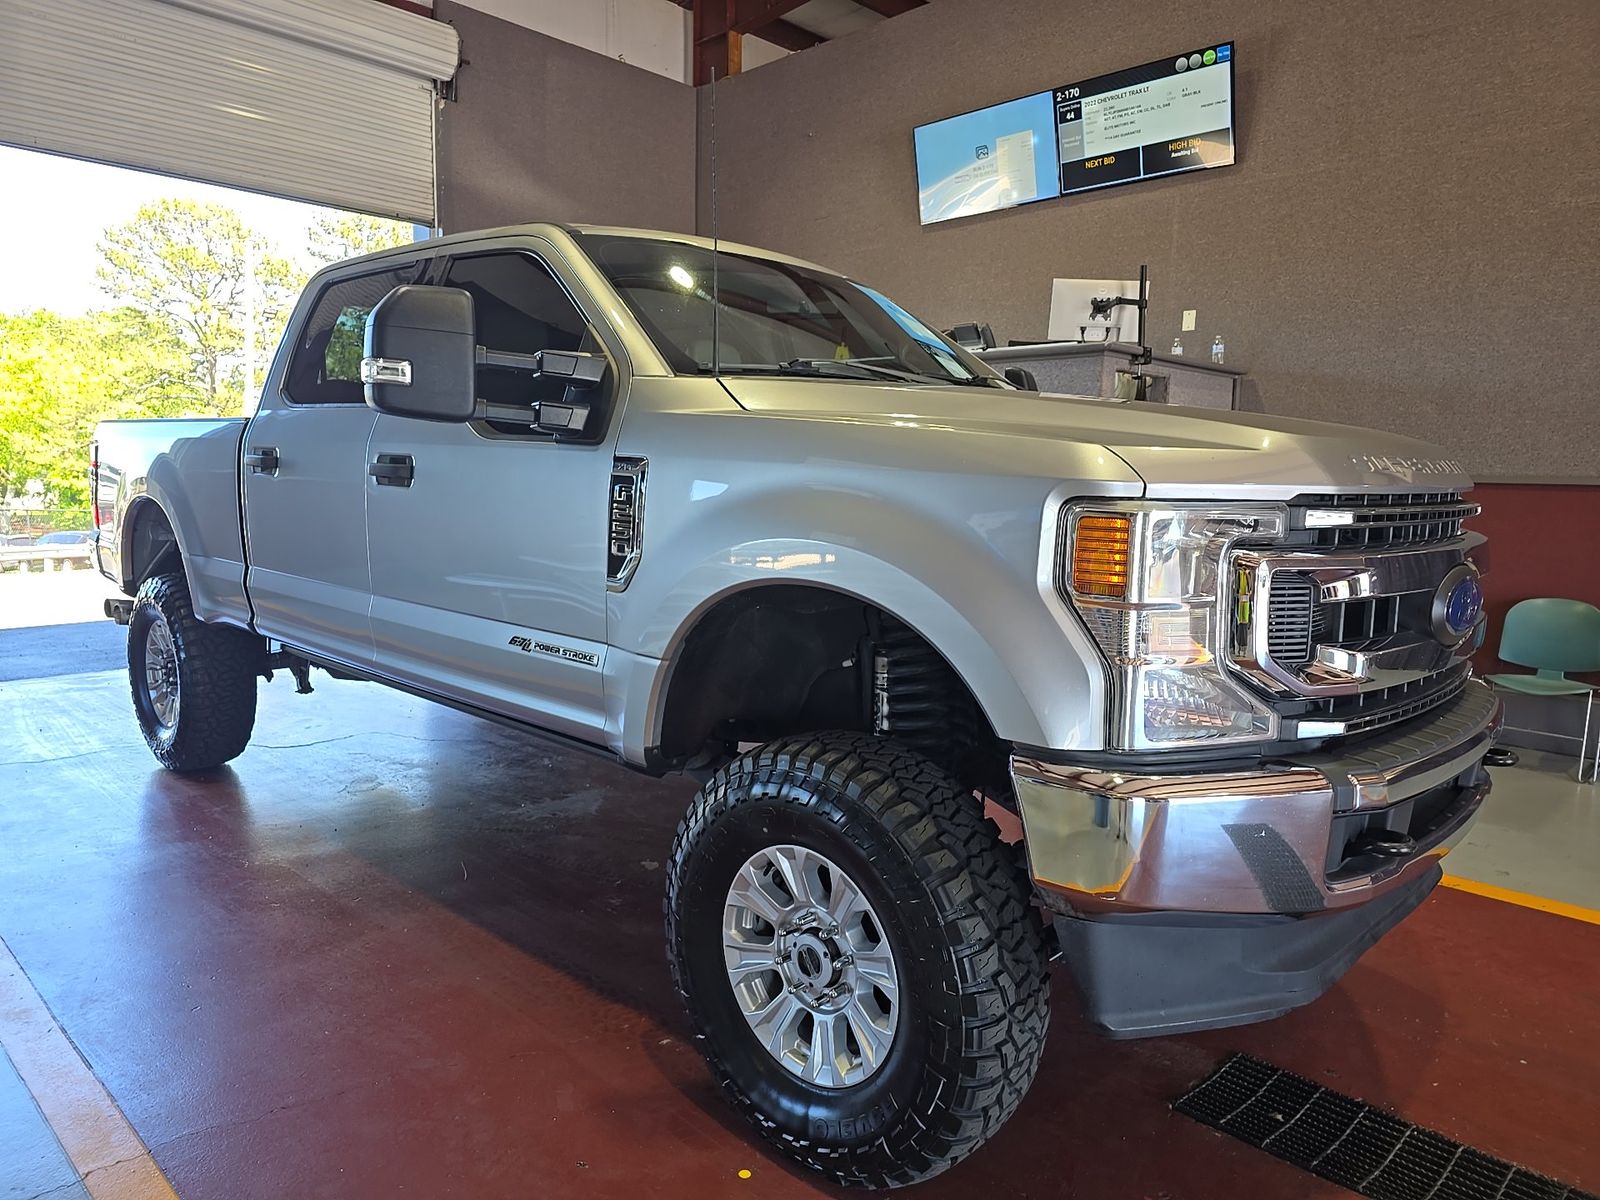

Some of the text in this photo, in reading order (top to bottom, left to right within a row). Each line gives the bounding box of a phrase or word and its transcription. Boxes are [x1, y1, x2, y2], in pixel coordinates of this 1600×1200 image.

[1056, 87, 1080, 101] 2-170
[1084, 100, 1097, 108] 2022
[1097, 91, 1127, 104] CHEVROLET
[1128, 88, 1142, 97] TRAX
[1066, 111, 1075, 120] 44
[1168, 137, 1201, 152] HIGH BID
[1085, 155, 1116, 169] NEXT BID
[534, 641, 560, 655] POWER
[561, 648, 595, 662] STROKE
